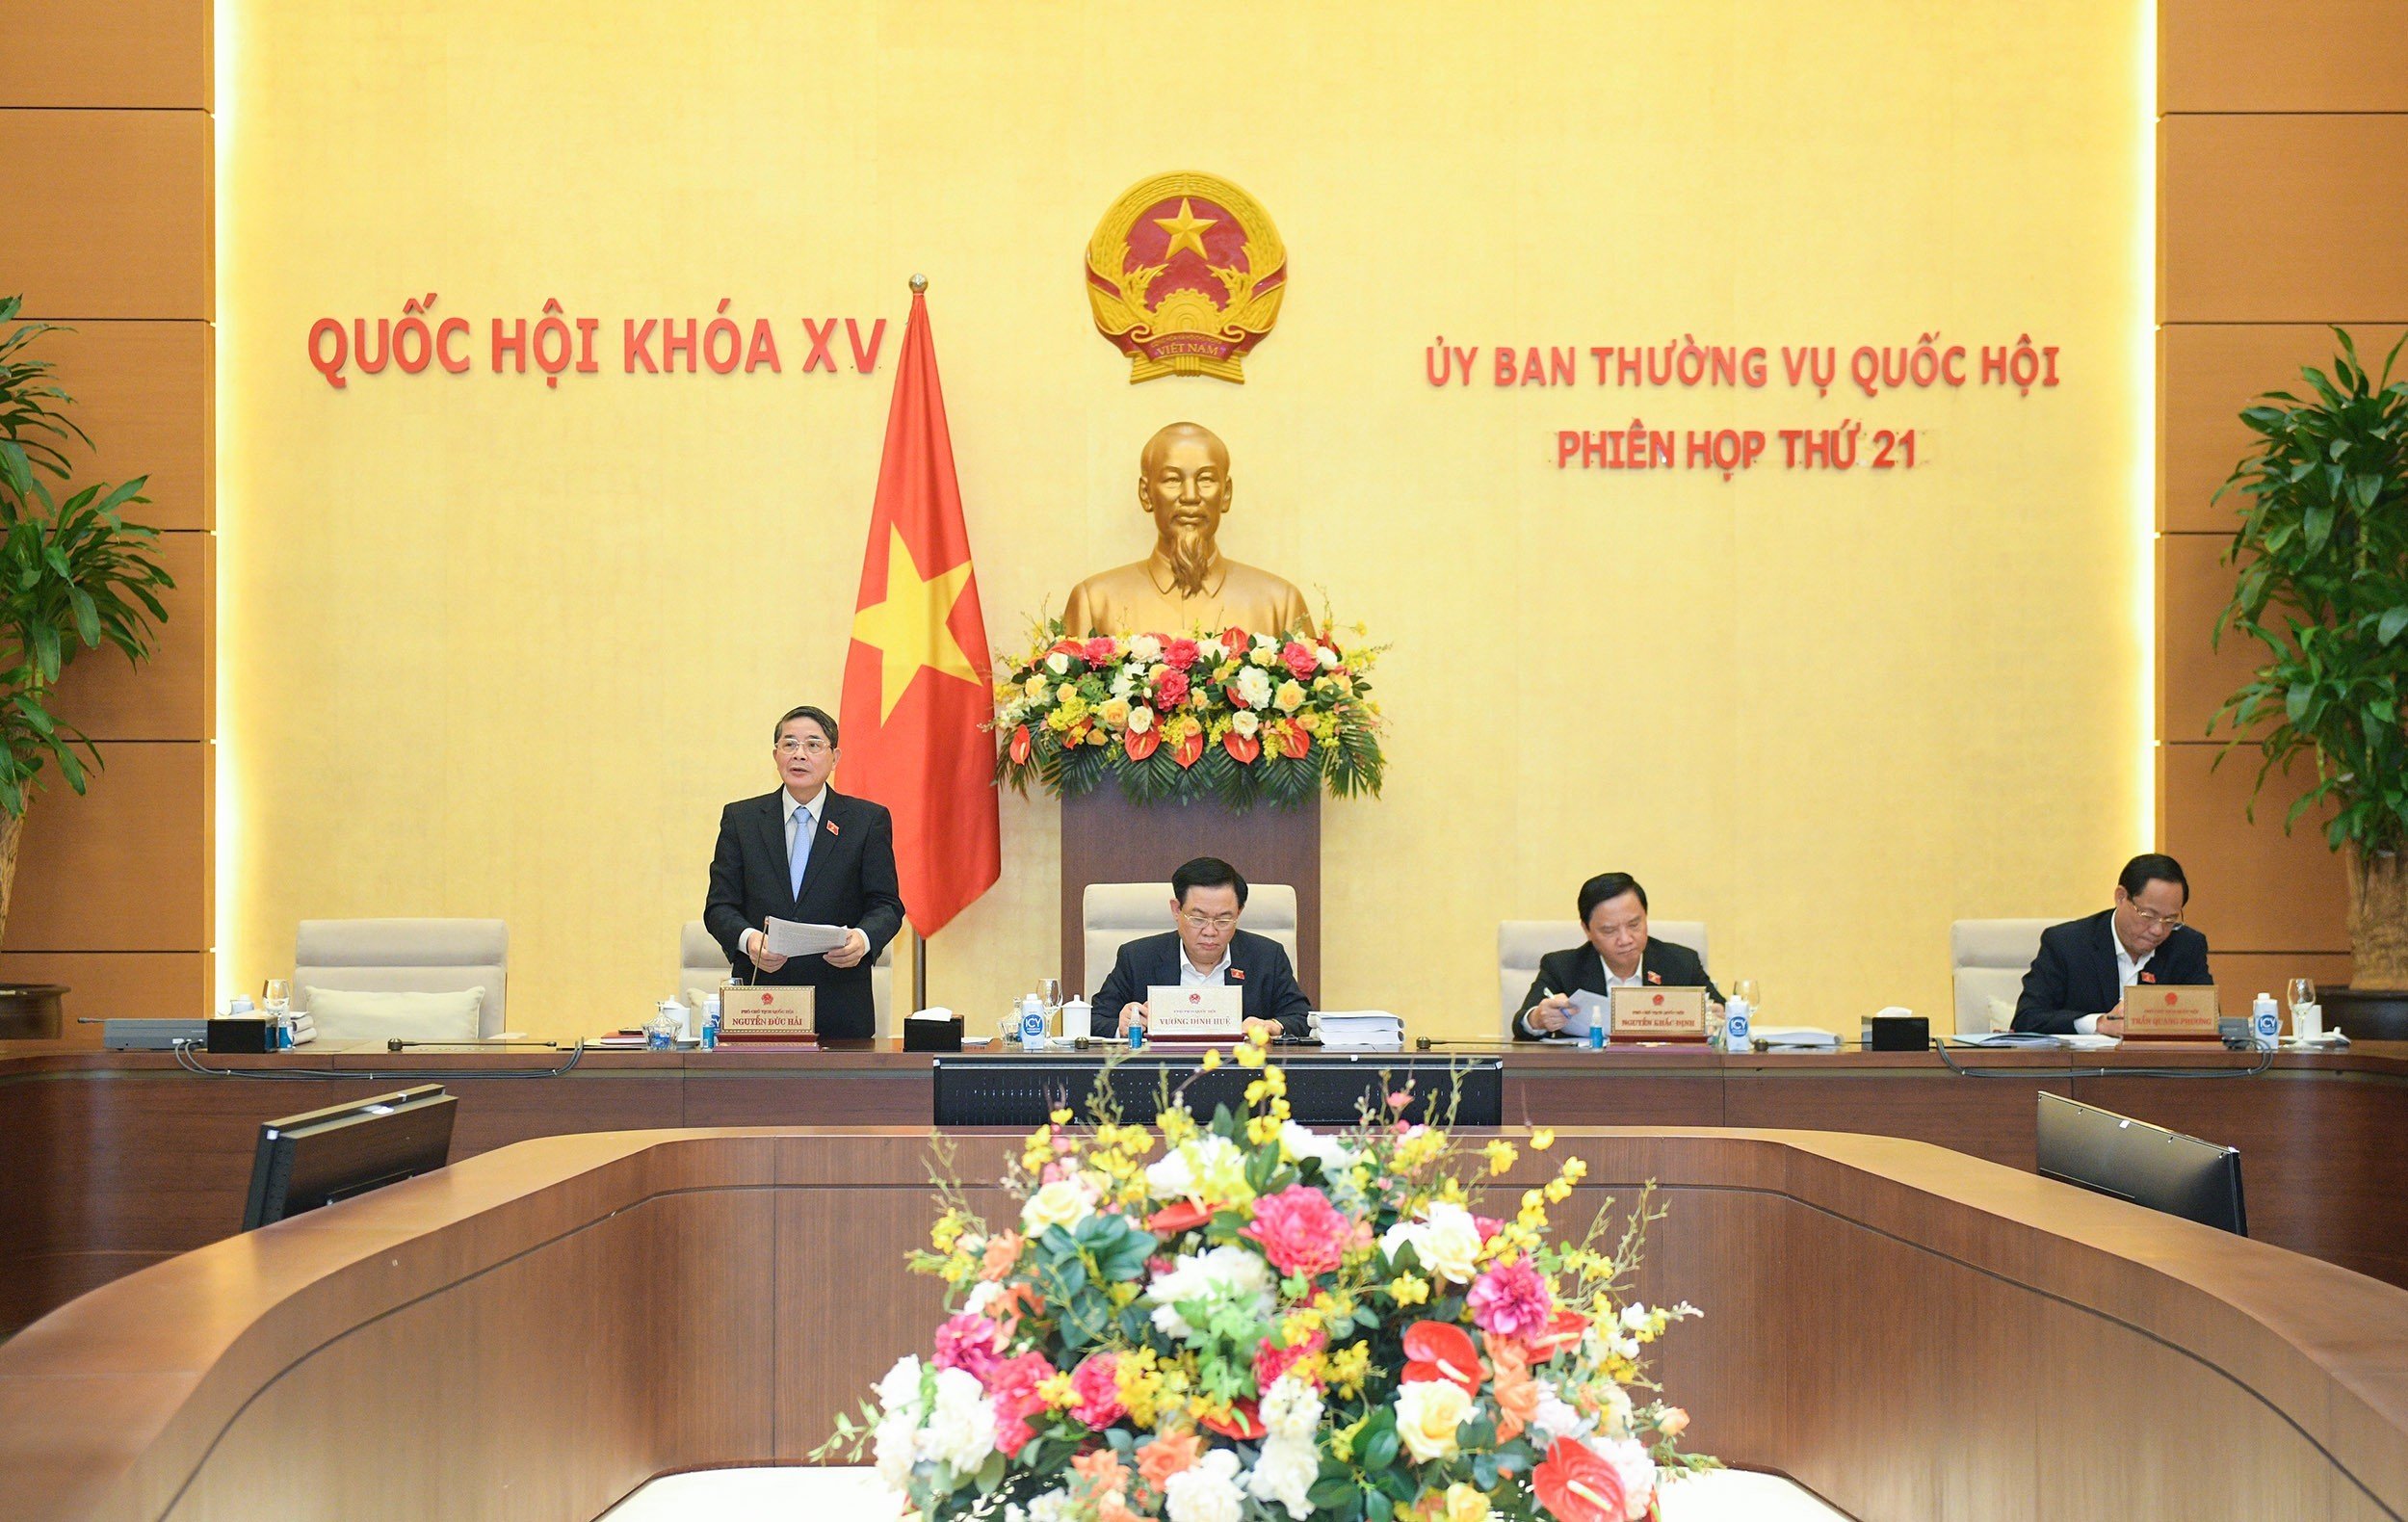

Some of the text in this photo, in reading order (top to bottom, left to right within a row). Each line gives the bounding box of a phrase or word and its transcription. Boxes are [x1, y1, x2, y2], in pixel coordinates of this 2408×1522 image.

[308, 293, 887, 388] QUỐC HỘI KHÓA XV
[1188, 343, 1218, 355] NAM
[1426, 332, 2060, 397] ỦY BAN THƯỜNG VỤ QUỐC HỘI
[1557, 418, 1916, 482] PHIÊN HỌP THỨ 21
[732, 1015, 767, 1026] NGUYỄN
[768, 1016, 786, 1026] ĐỨC
[787, 1015, 802, 1026] HẢI
[1025, 1017, 1041, 1028] ICY
[2260, 1017, 2276, 1028] ICY
